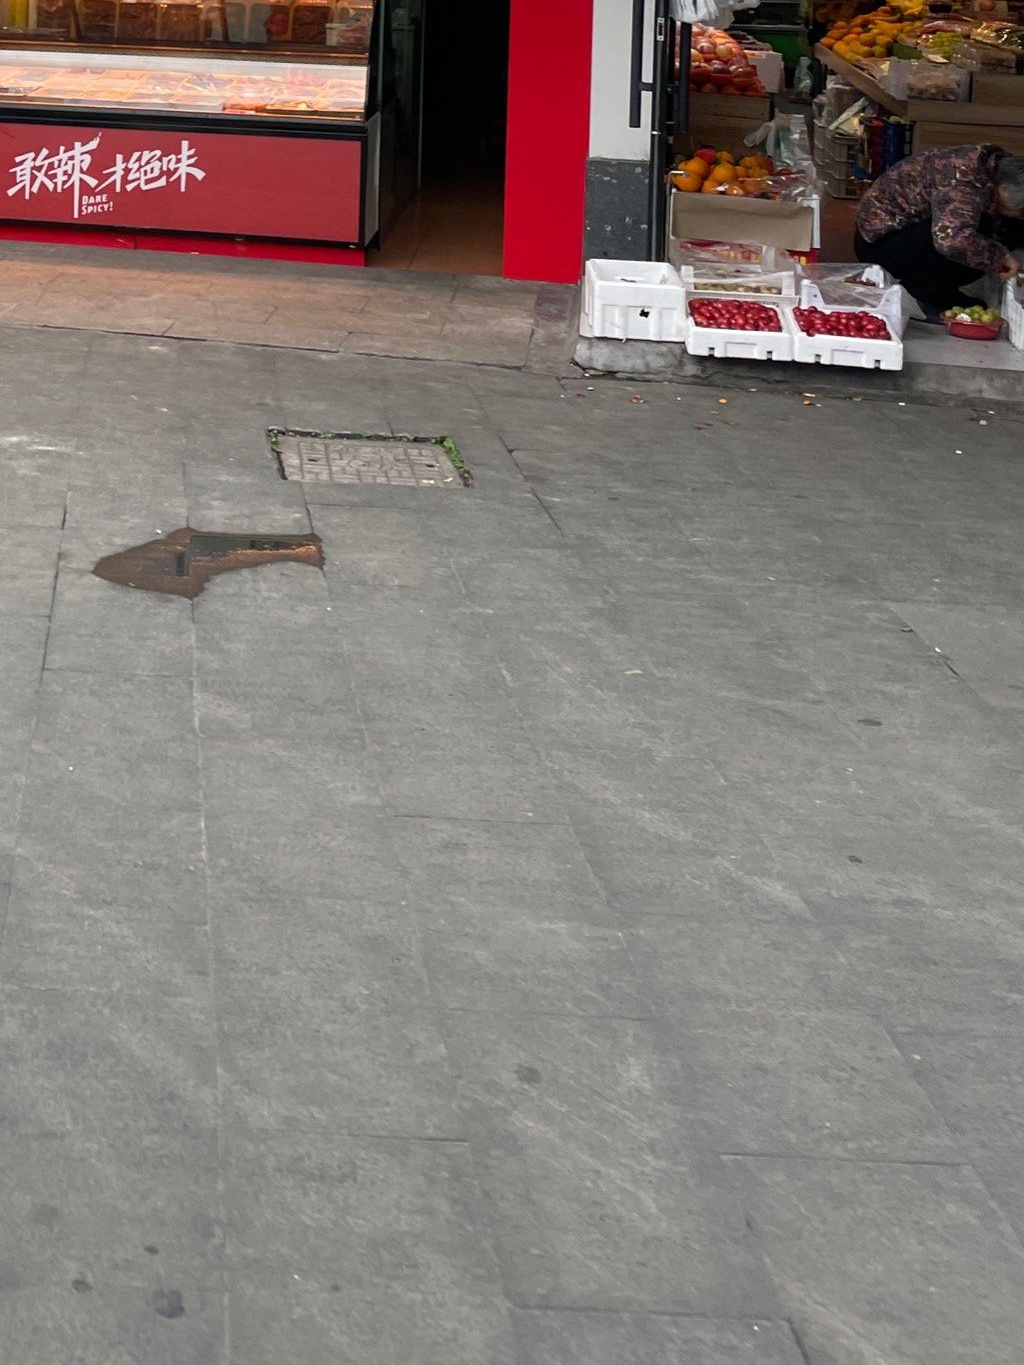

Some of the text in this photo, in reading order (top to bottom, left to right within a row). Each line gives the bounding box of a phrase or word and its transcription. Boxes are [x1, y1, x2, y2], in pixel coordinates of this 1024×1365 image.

[6, 132, 207, 219] 敢辣才绝味
[82, 194, 108, 205] DARE
[82, 202, 114, 215] SPICY!
